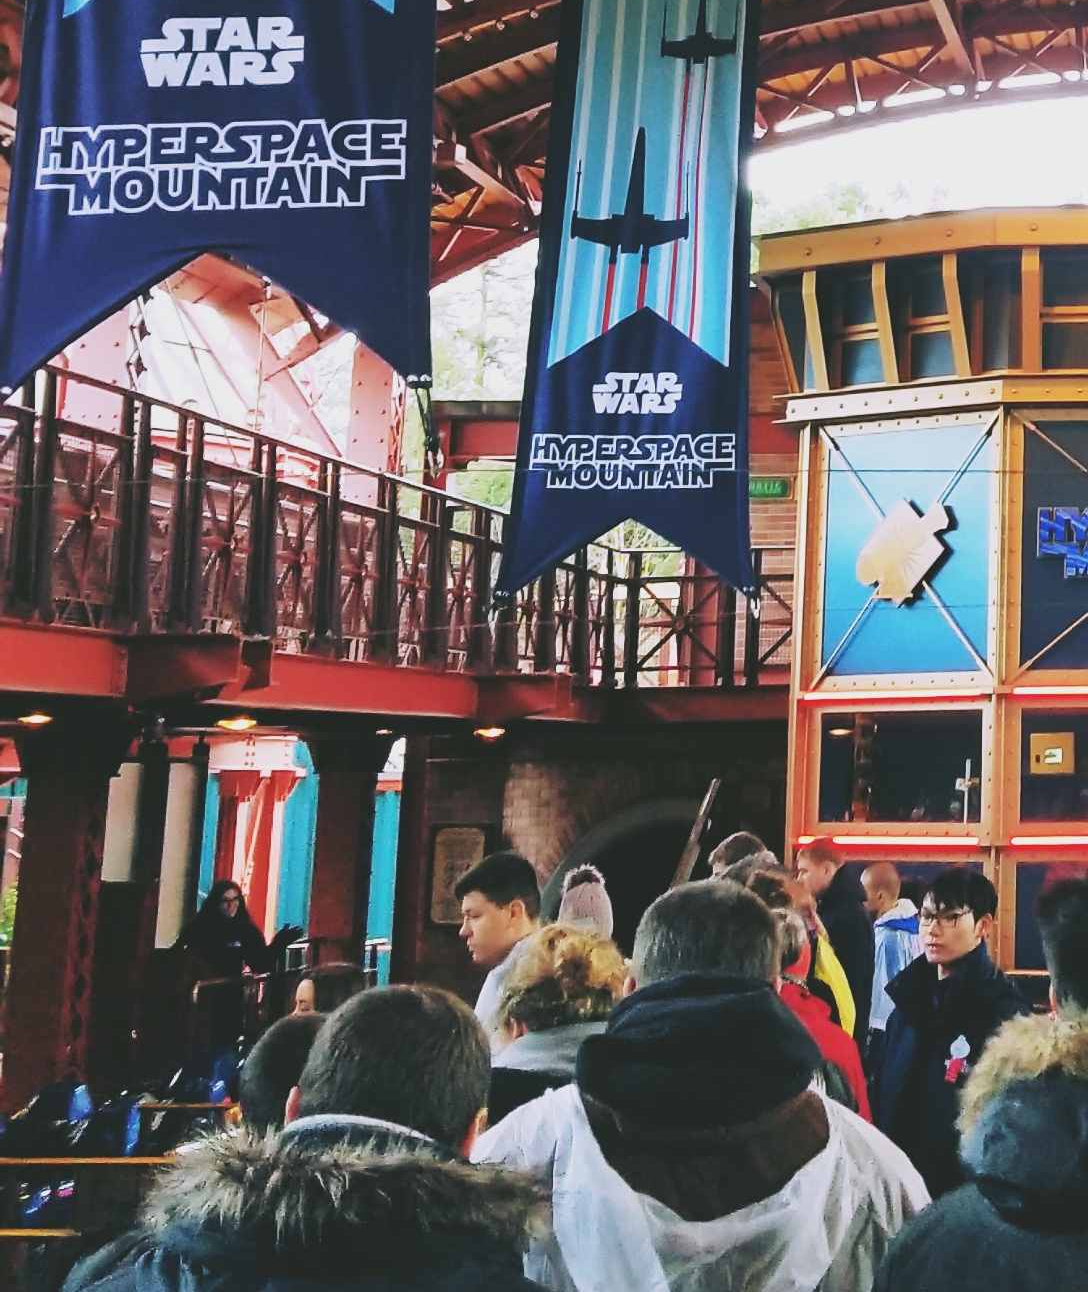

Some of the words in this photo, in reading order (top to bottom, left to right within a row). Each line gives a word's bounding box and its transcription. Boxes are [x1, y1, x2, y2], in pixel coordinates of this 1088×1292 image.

[140, 16, 304, 52] STAR
[140, 49, 304, 87] WARS
[39, 119, 407, 172] HYPERSPACE
[35, 162, 406, 215] MOUNTAIN
[592, 372, 683, 393] STAR
[592, 391, 682, 414] WARS
[532, 433, 735, 462] HYPERSPACE
[529, 459, 735, 489] MOUNTAIN
